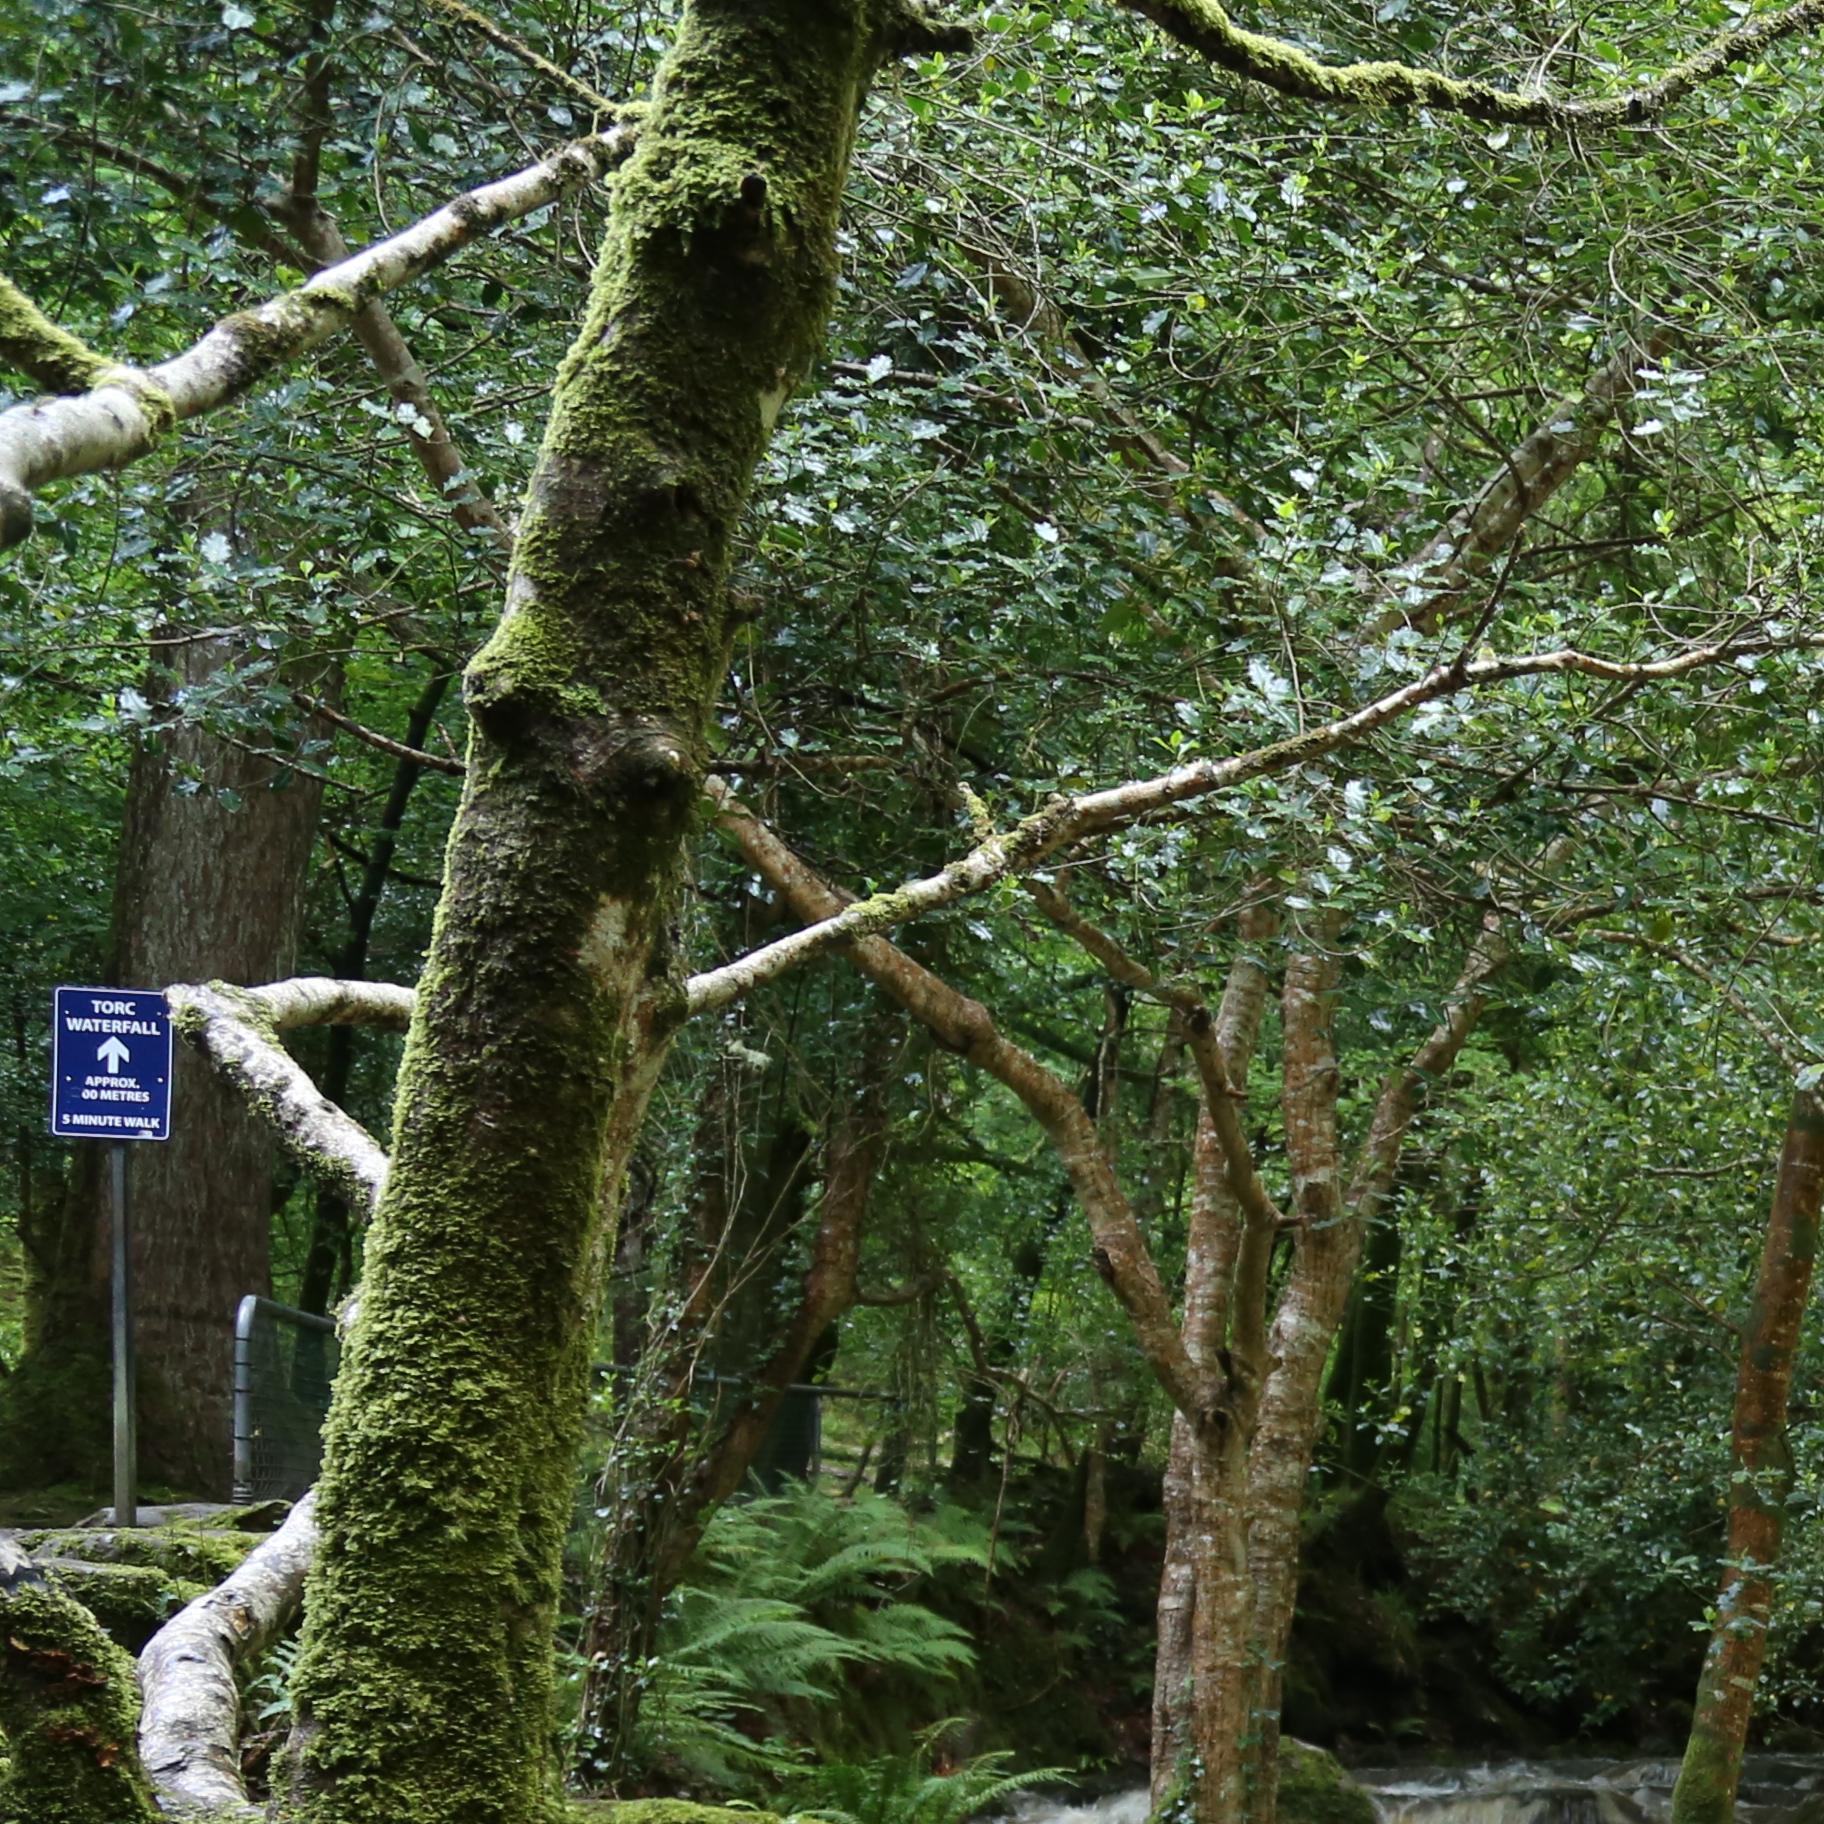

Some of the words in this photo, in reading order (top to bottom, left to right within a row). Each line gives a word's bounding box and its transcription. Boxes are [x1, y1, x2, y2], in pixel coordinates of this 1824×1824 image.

[91, 1000, 136, 1015] TORC
[66, 1017, 160, 1035] WATERFALL
[85, 1076, 140, 1089] APPROX.
[100, 1090, 150, 1102] METRES
[62, 1114, 70, 1124] 5
[73, 1114, 122, 1127] MINUTE
[124, 1116, 160, 1128] WALK
